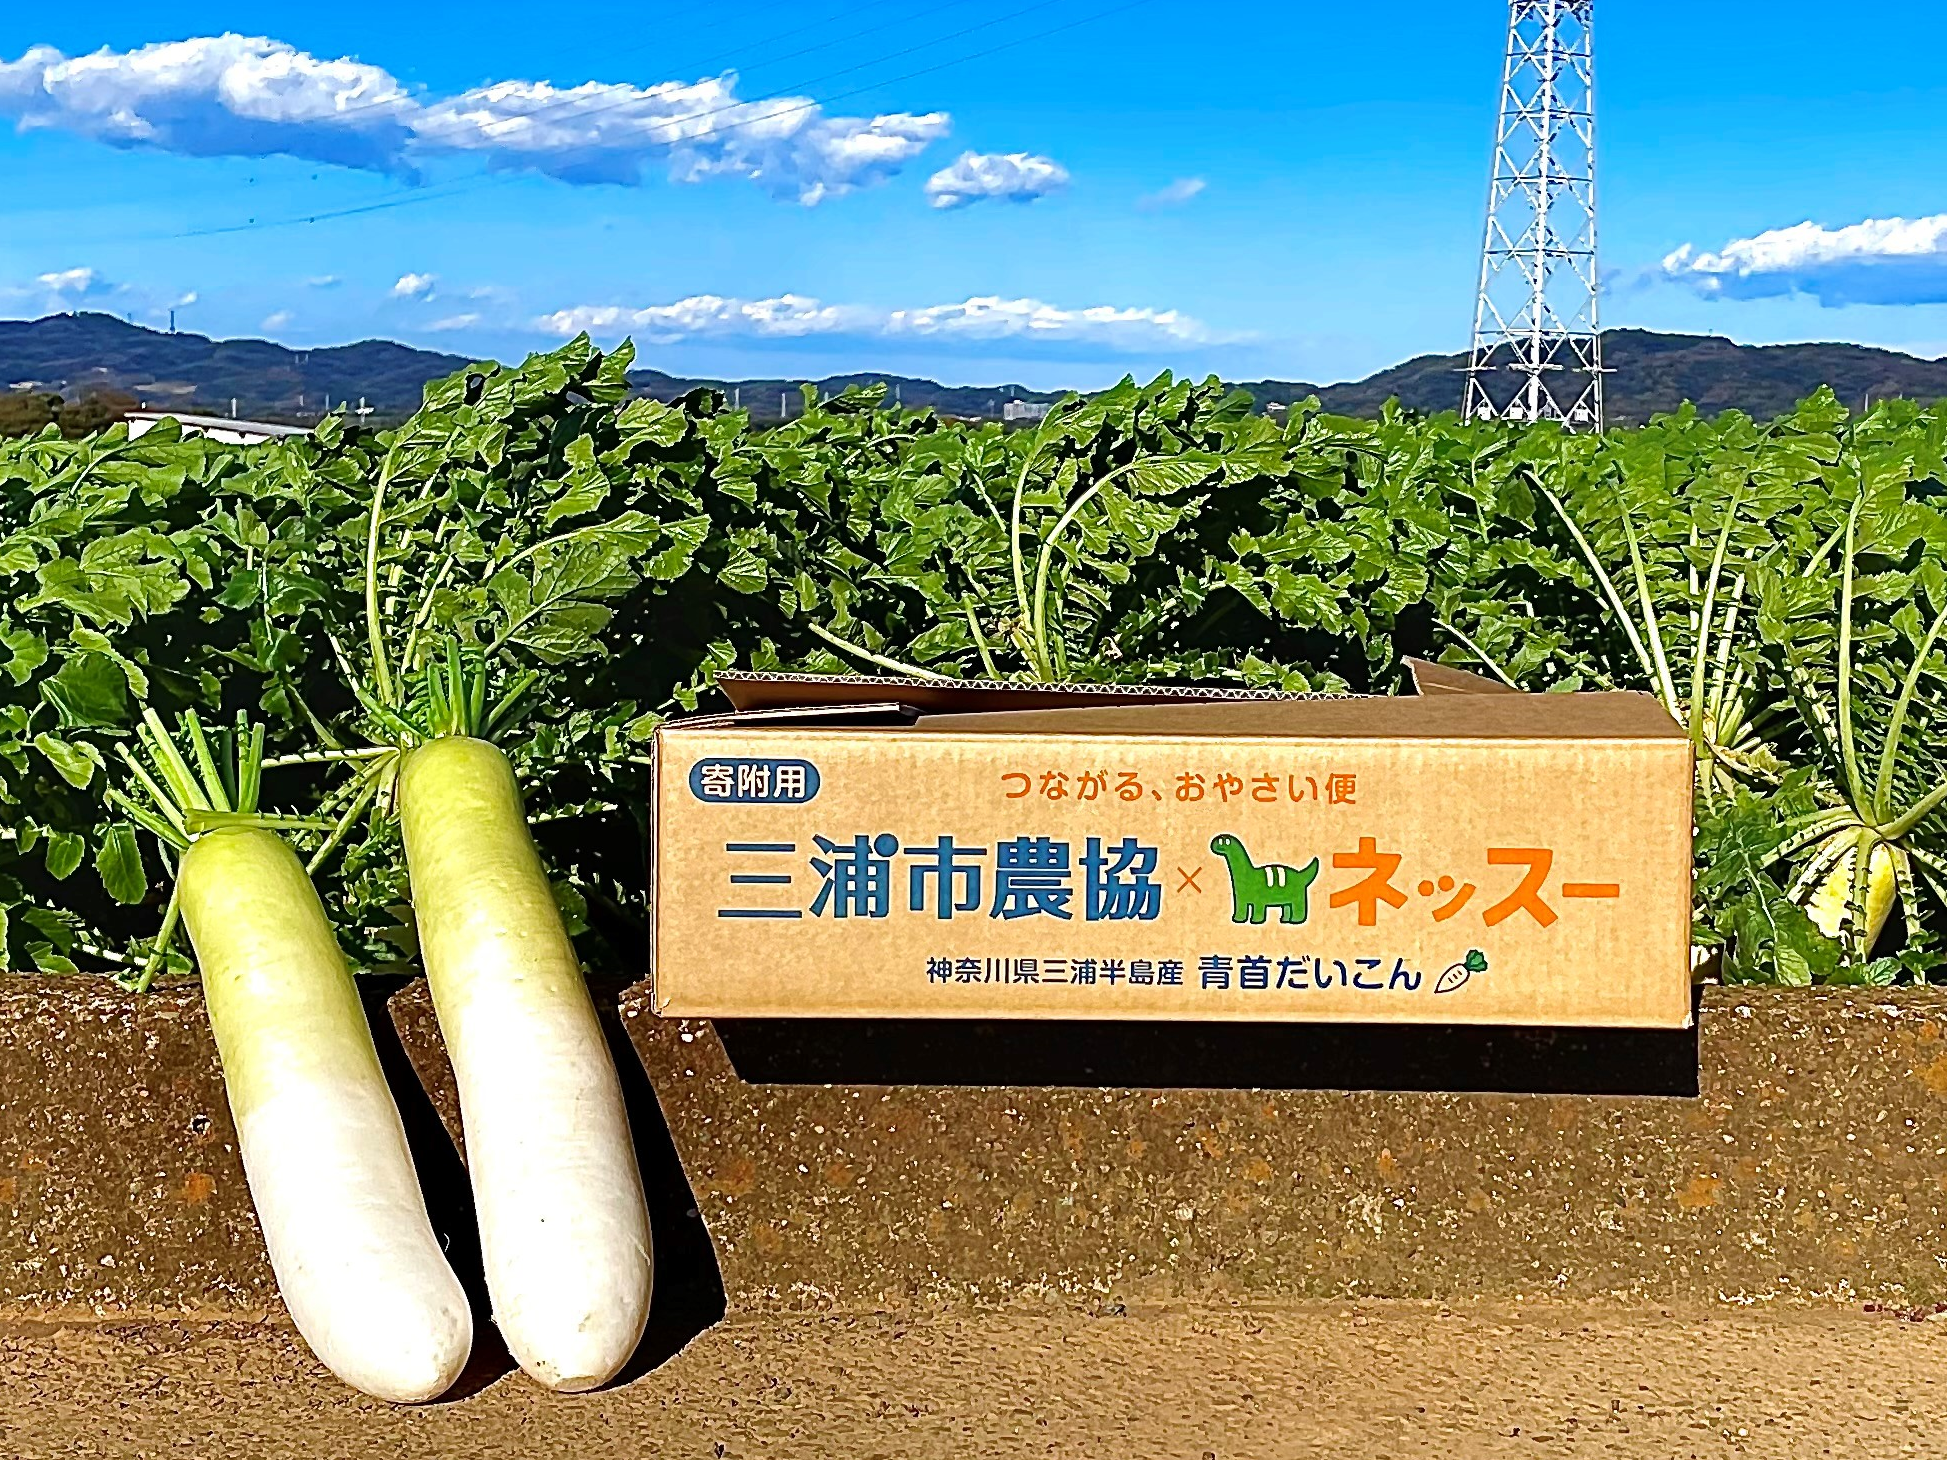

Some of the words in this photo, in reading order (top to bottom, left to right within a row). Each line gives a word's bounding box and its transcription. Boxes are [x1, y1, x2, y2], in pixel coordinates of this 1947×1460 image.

[700, 763, 806, 800] 寄附用
[1000, 770, 1357, 805] つながる、おやさい便
[717, 833, 1163, 921] 三浦市農協
[1329, 836, 1621, 928] ネッスー
[926, 956, 1184, 986] 神奈川県三浦半島産
[1197, 954, 1422, 990] 青首だいこん
